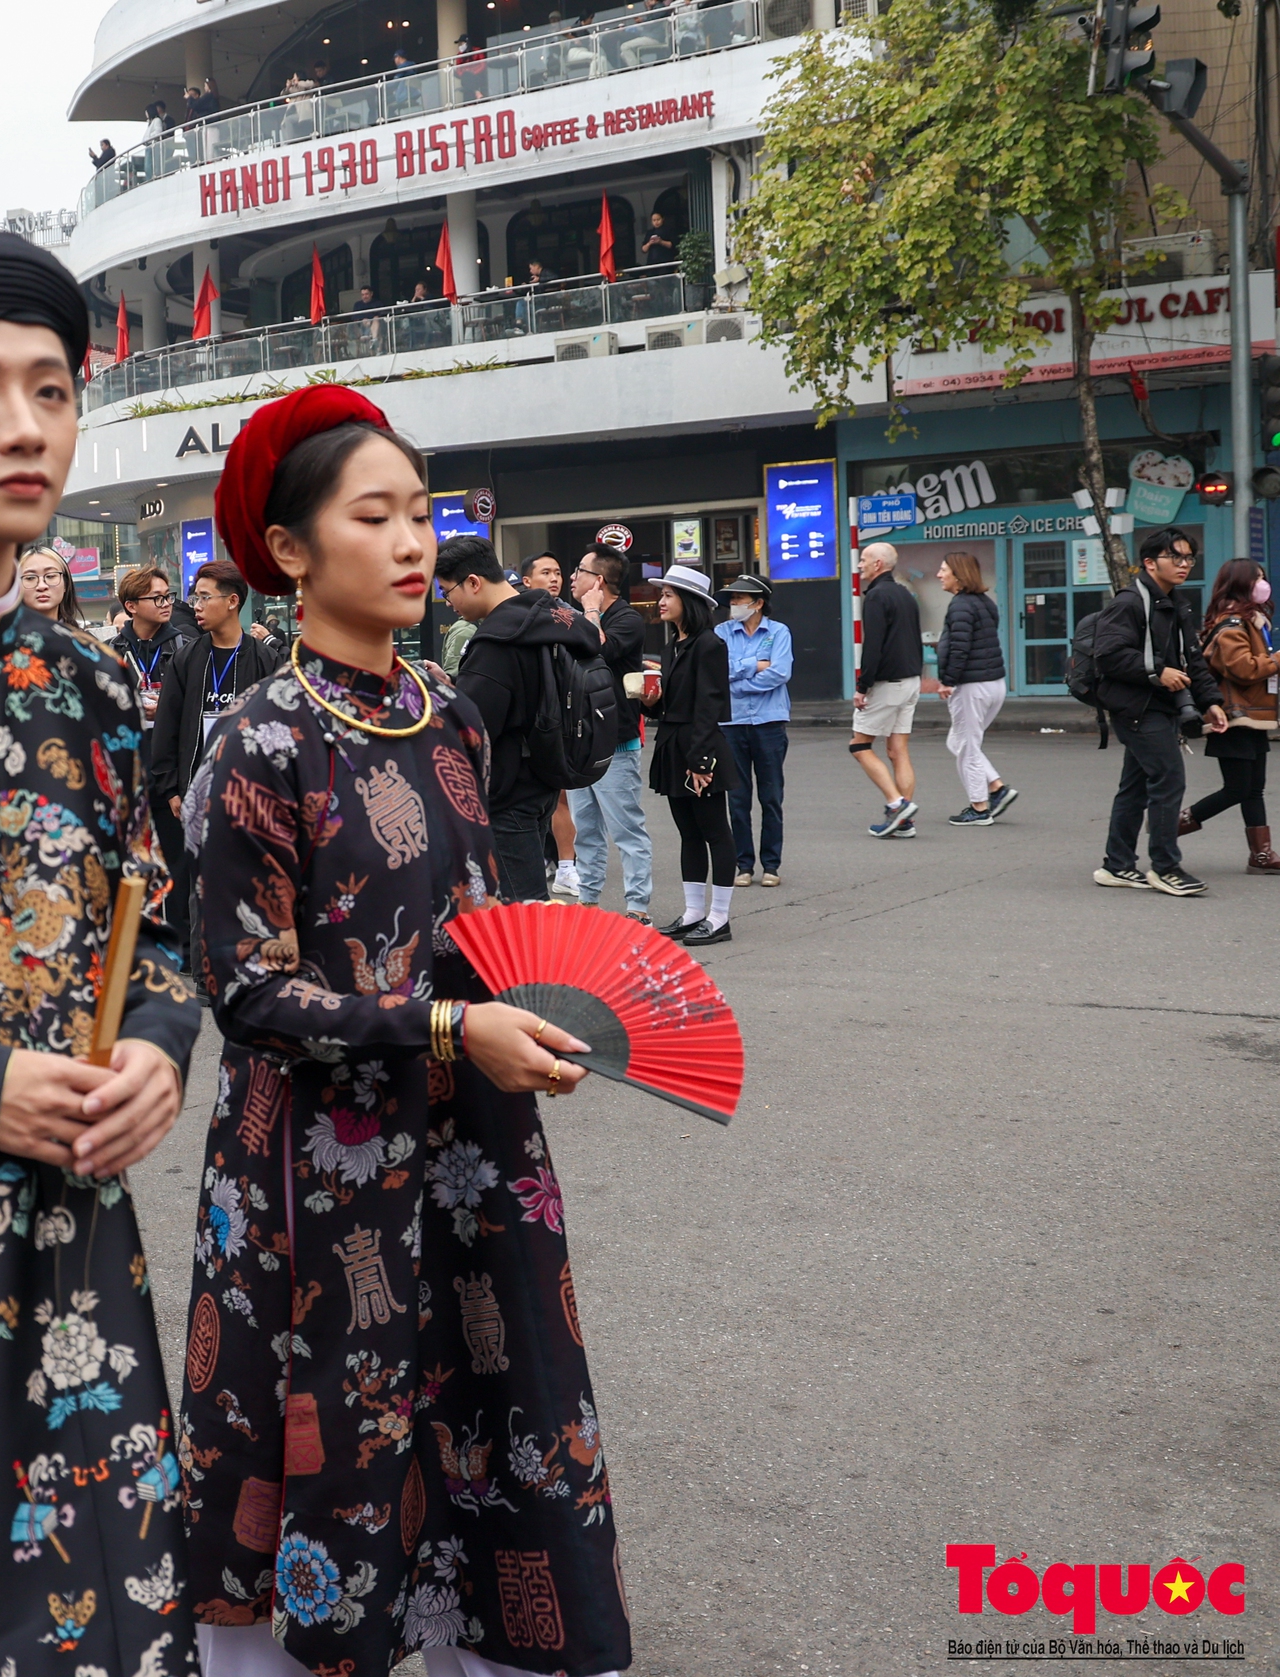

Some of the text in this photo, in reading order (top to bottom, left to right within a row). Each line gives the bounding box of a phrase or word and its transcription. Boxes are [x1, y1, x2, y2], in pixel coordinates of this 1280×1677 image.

[200, 90, 714, 217] HANOI 1930 BISTRO COFFEE & RESTAURANT
[965, 373, 995, 385] 3934
[1135, 486, 1174, 504] Dairy
[140, 499, 164, 521] ALDO
[1133, 500, 1170, 518] Vegan
[923, 521, 1007, 539] HOMEMADE
[1030, 518, 1054, 533] ICE
